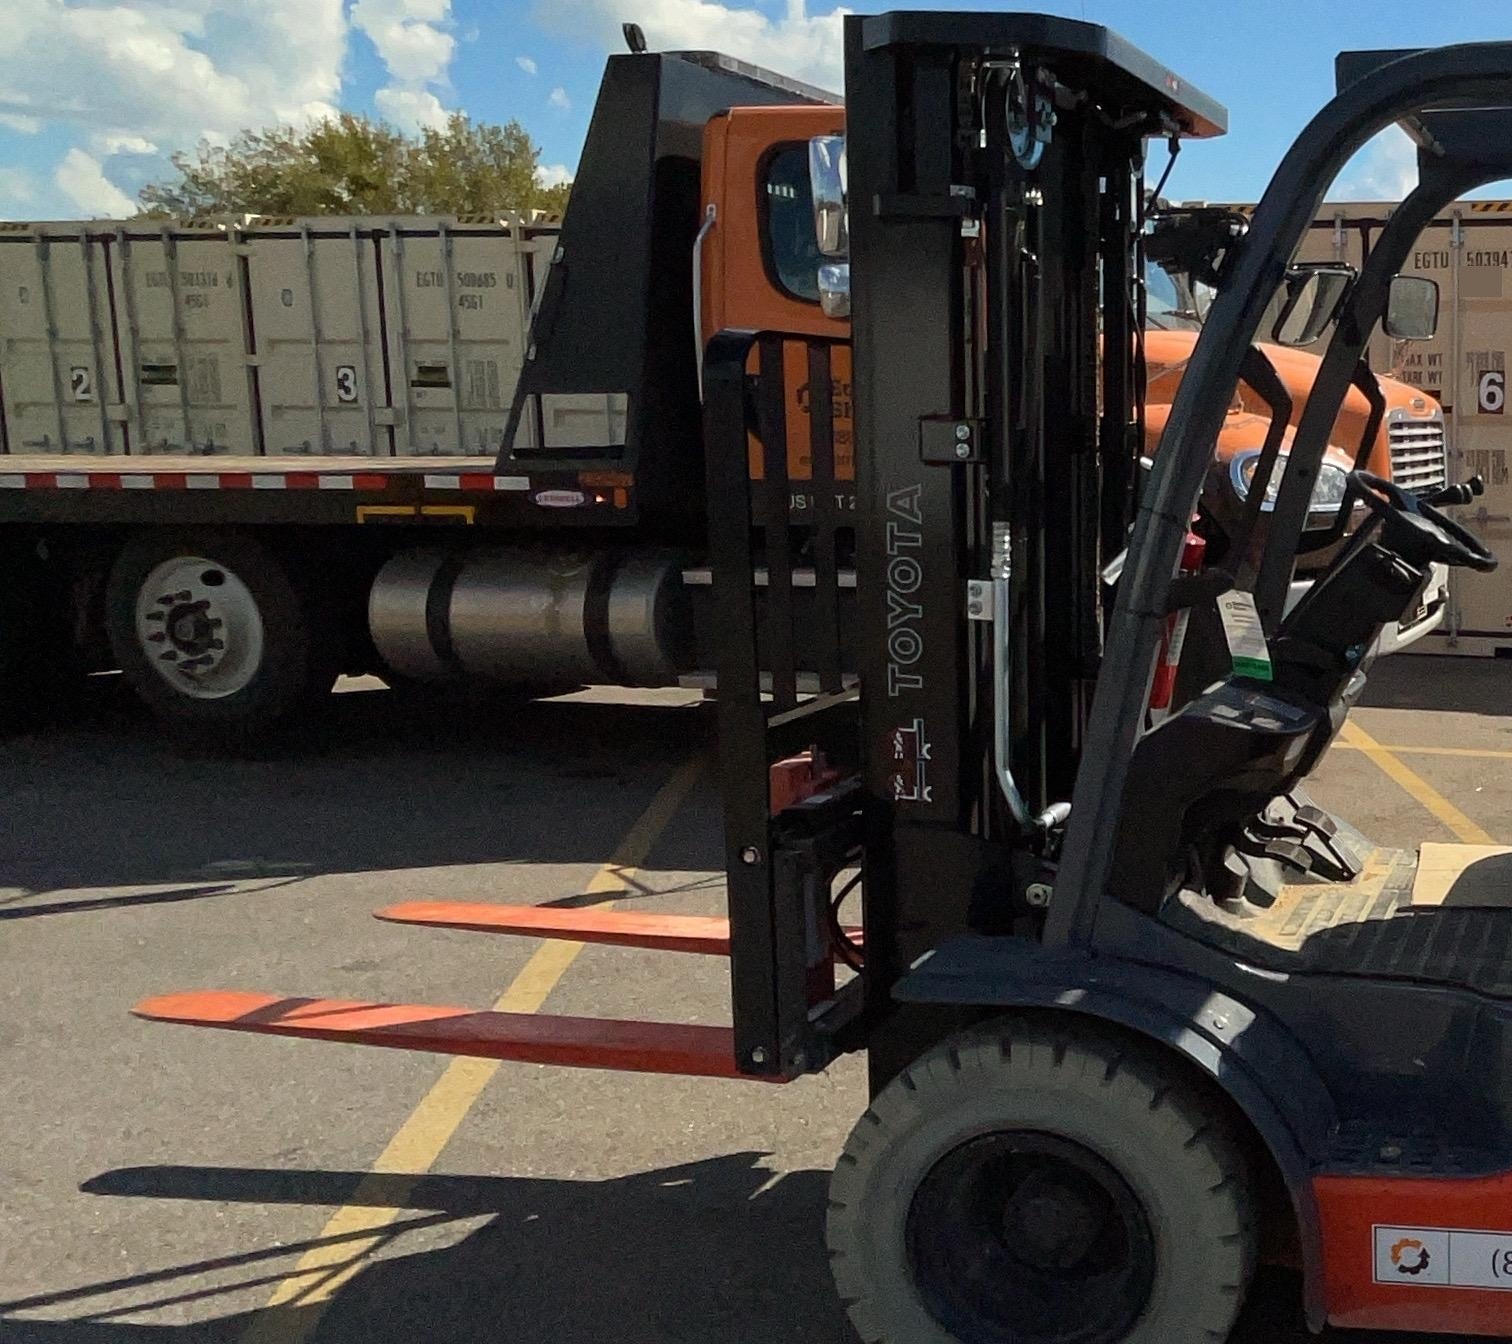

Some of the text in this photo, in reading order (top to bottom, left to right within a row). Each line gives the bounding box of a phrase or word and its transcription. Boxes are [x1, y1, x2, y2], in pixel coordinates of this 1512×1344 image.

[1414, 252, 1449, 269] EGTU
[71, 368, 93, 402] 2
[337, 366, 357, 401] 3
[1479, 372, 1504, 411] 6
[886, 483, 923, 698] TOYOTA
